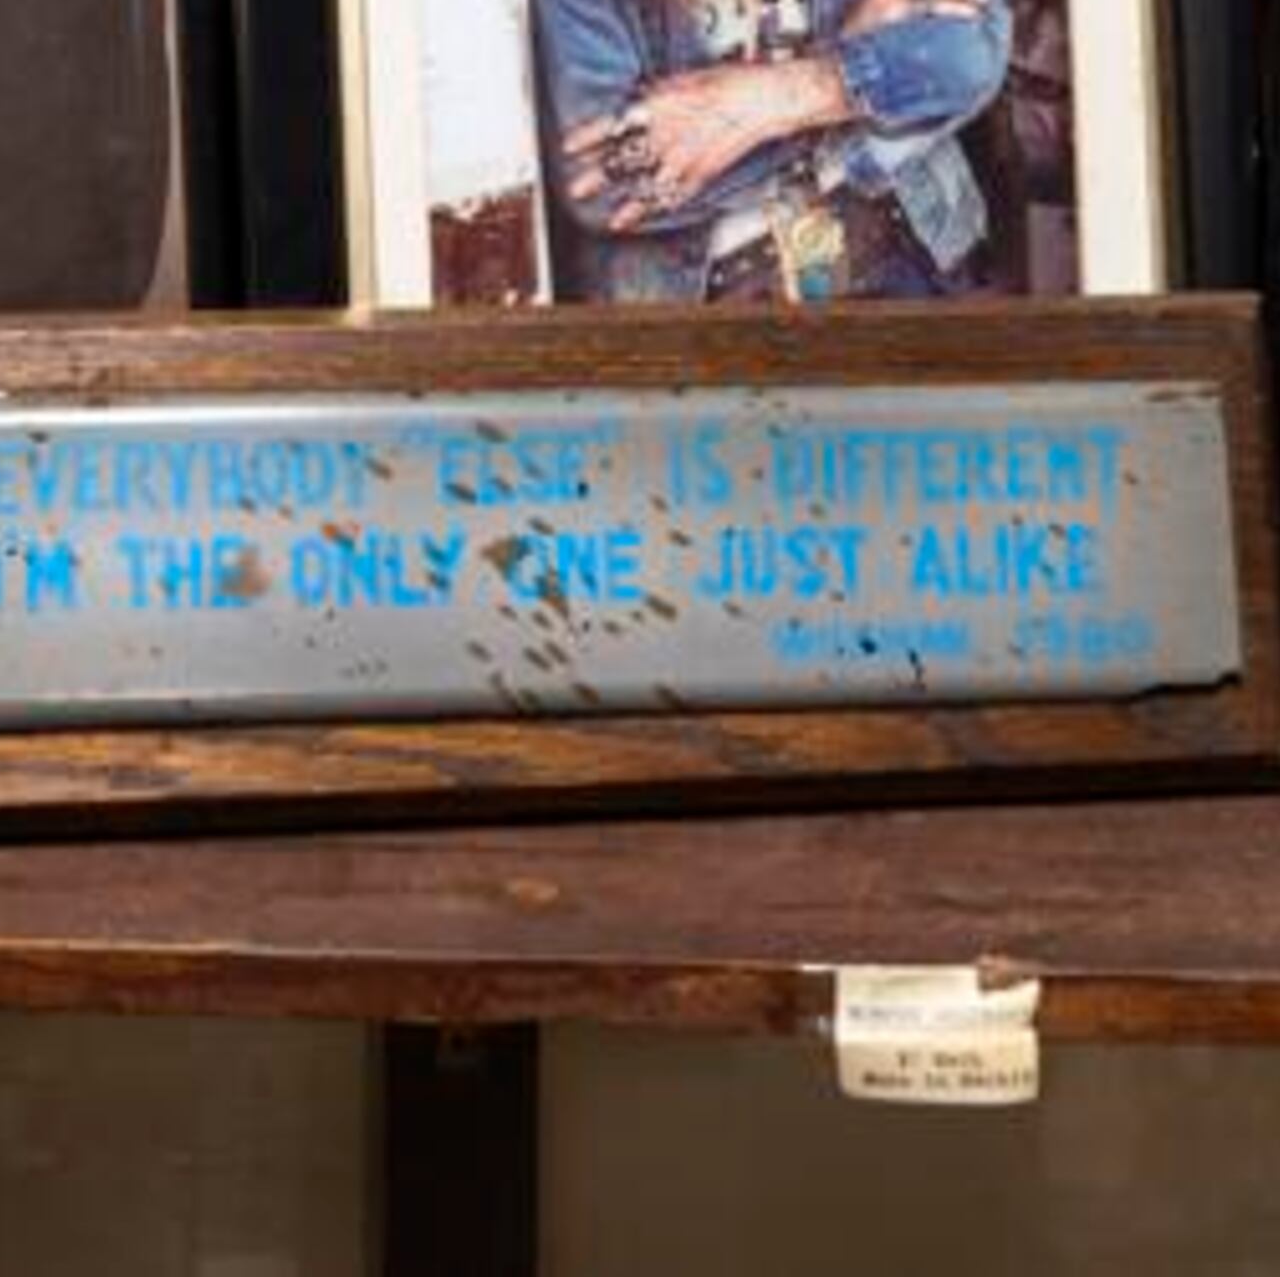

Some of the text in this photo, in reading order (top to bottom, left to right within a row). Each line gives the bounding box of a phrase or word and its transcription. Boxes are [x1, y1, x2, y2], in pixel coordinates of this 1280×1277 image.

[668, 421, 733, 506] IS
[772, 426, 1122, 519] DIFFERENT
[120, 534, 256, 609] THE
[290, 528, 467, 609] ONLY
[503, 530, 643, 604] ONE
[693, 526, 866, 602] JUST
[912, 523, 1096, 600] ALIKE
